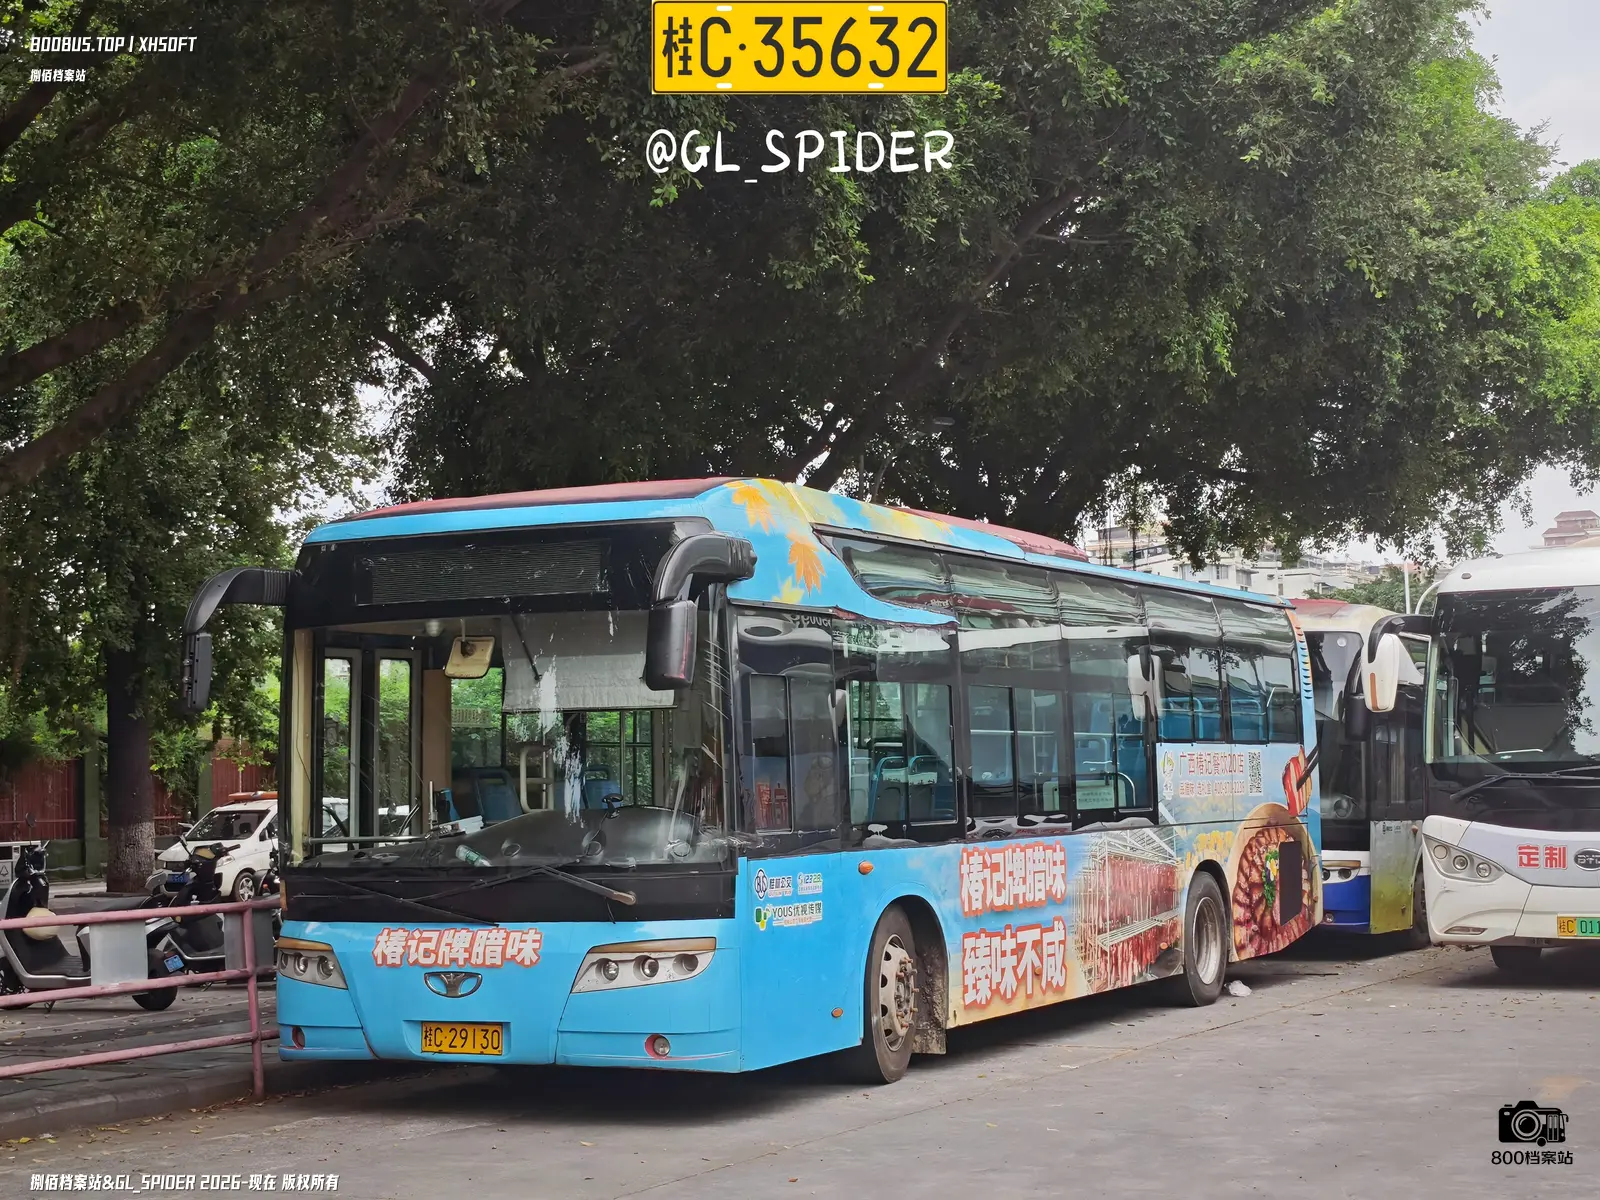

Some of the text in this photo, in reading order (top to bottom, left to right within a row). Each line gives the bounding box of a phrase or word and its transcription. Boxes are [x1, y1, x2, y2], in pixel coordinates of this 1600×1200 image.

[960, 843, 1066, 914] 椿记牌腊味
[1517, 845, 1567, 870] 定制
[372, 928, 542, 967] 椿记牌腊味
[963, 919, 1066, 1006] 臻味不咸
